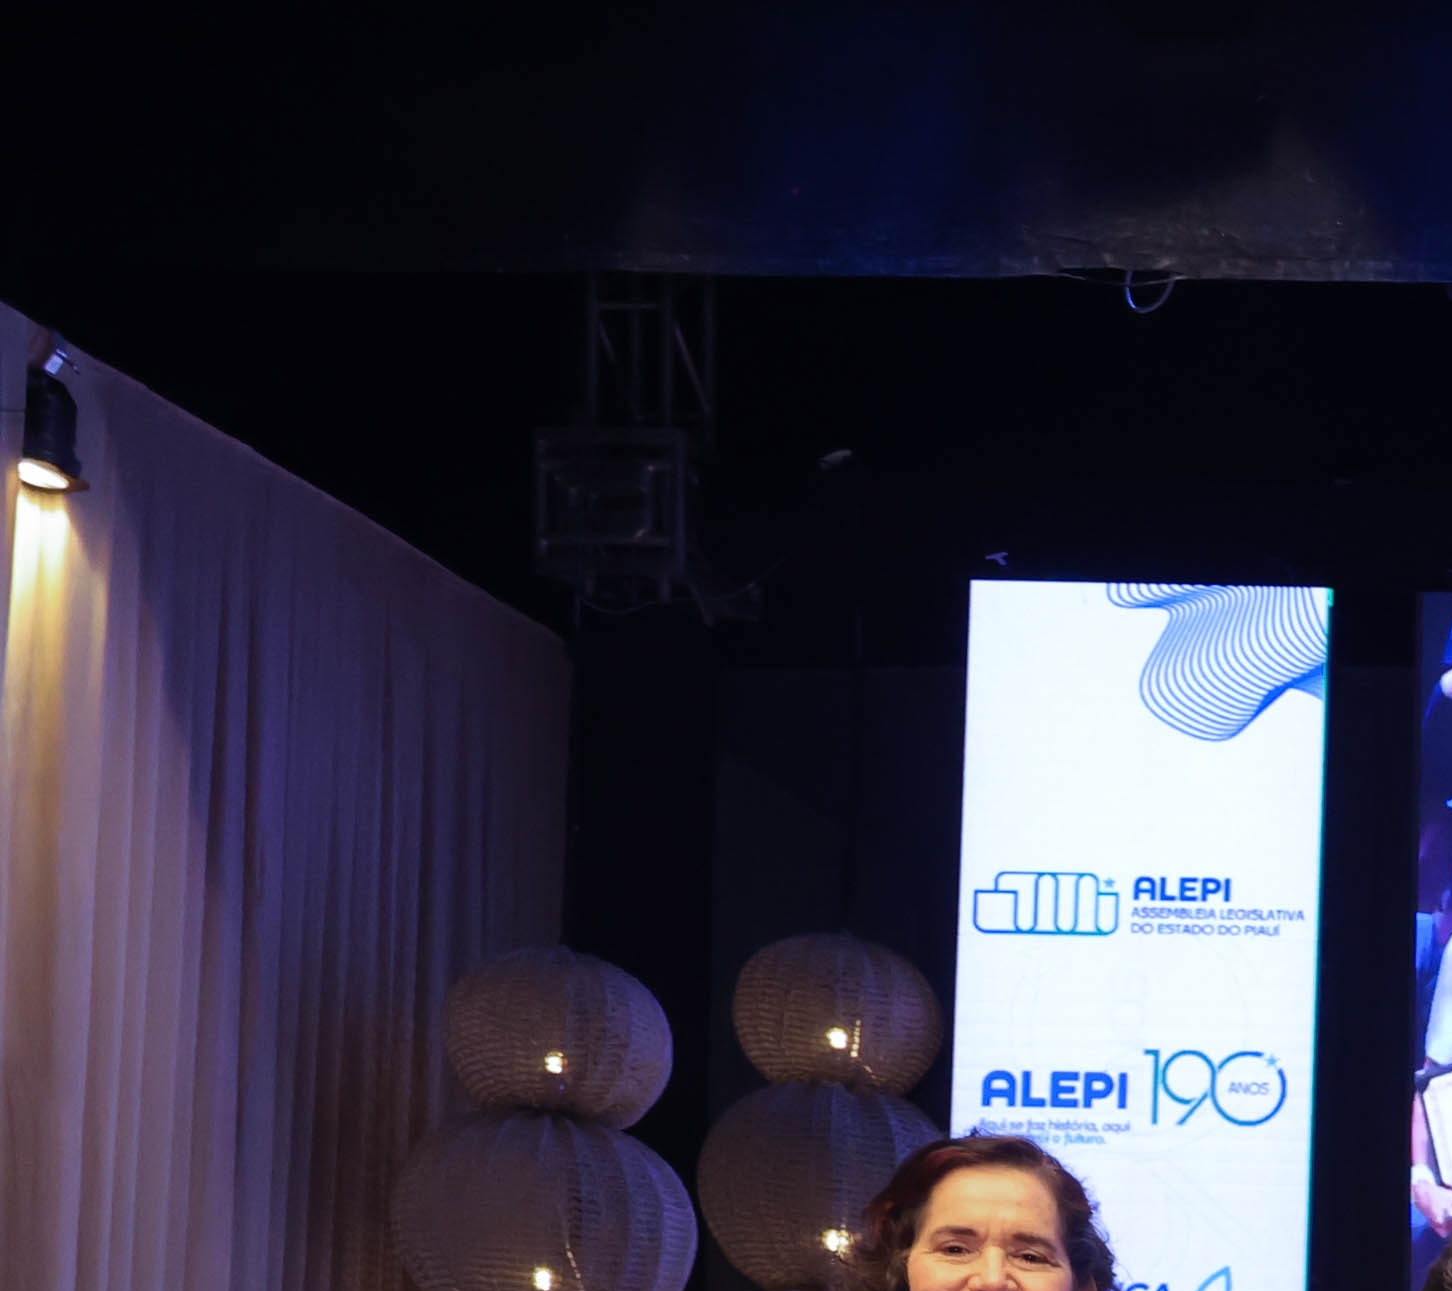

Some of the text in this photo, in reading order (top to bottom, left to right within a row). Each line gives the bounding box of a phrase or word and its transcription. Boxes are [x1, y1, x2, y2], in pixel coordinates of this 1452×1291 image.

[1133, 876, 1232, 902] ALEPI
[1131, 907, 1305, 921] ASSEMBLEIA LEGISLATIVA
[1131, 923, 1280, 937] DO ESTADO DO PIAUÍ
[981, 1049, 1287, 1126] ALEPI 190 ANOS
